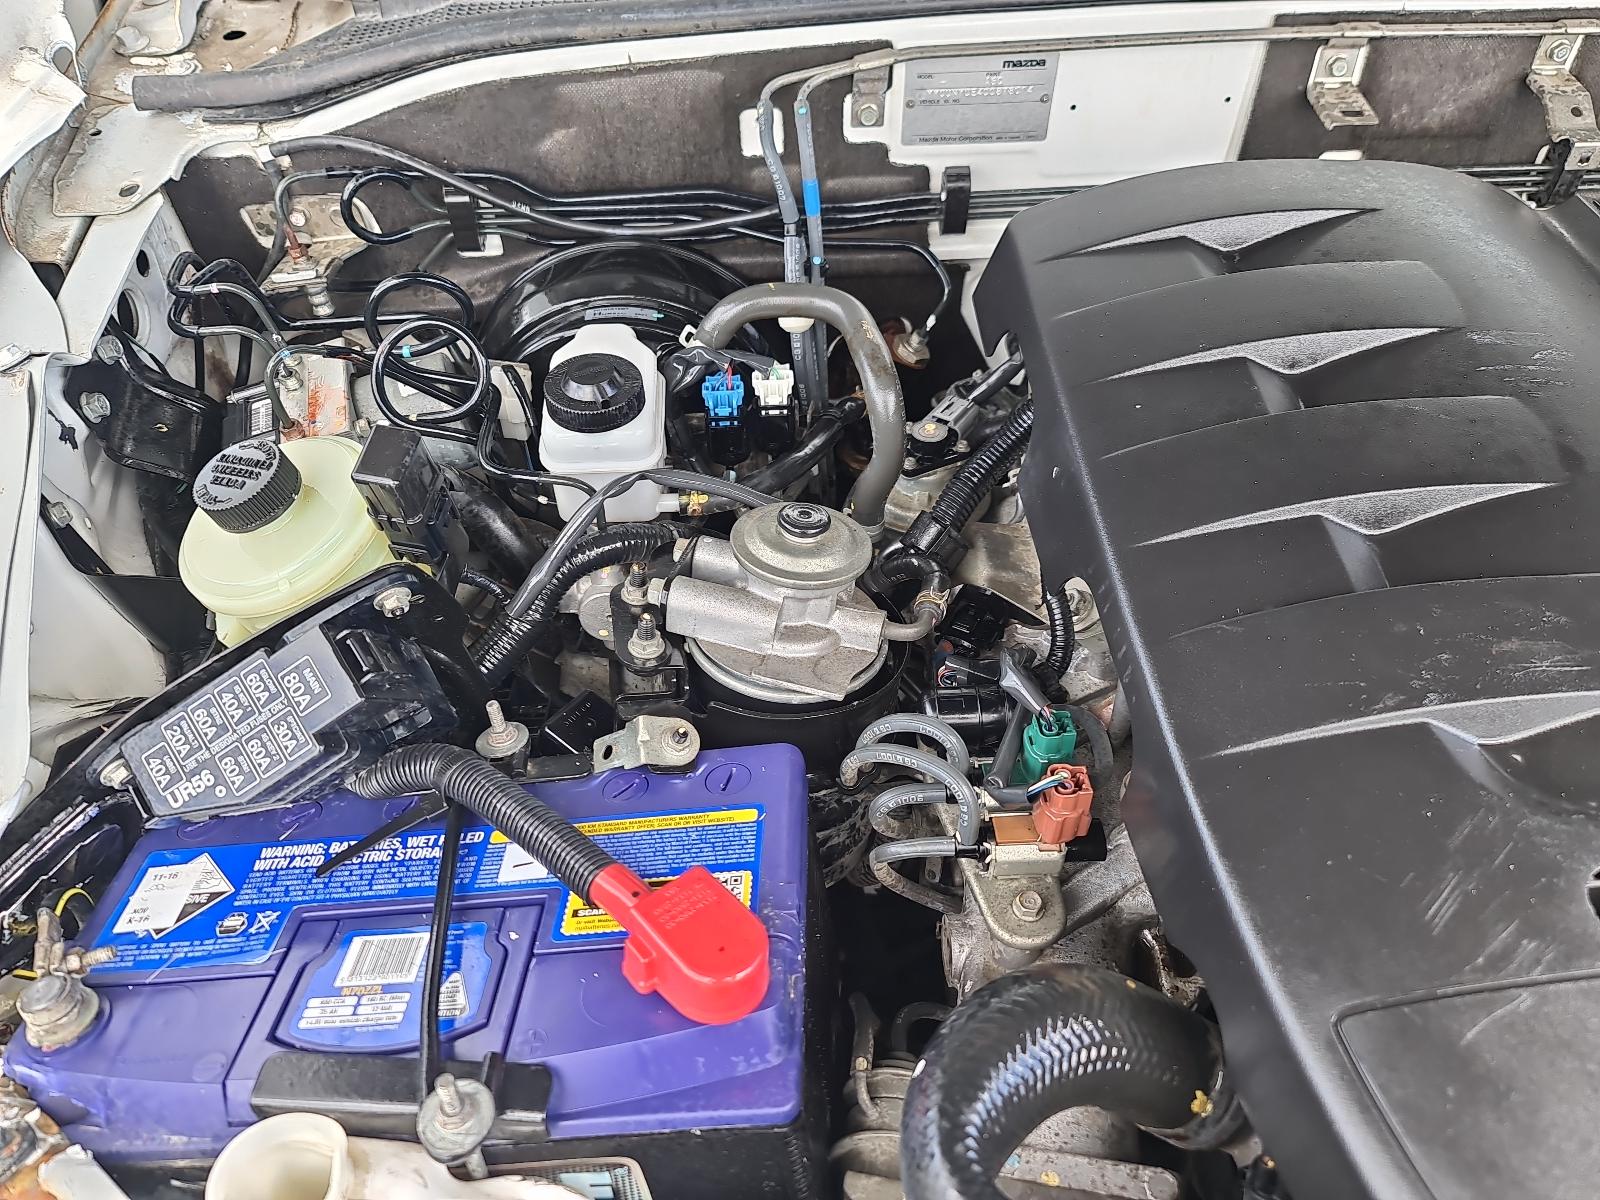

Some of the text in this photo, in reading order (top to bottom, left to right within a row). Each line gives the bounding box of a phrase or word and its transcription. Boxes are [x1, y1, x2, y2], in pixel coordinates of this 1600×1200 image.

[1002, 59, 1046, 68] mazda
[246, 672, 270, 705] 60A
[284, 672, 312, 711] 80A
[302, 668, 322, 694] MAIN
[194, 708, 218, 740] 60A
[221, 692, 244, 723] 40A
[166, 725, 191, 758] 20A
[182, 759, 198, 772] USE
[197, 750, 212, 763] THE
[270, 698, 289, 714] ONLY
[274, 720, 298, 754] 30A
[248, 738, 272, 772] 60A
[148, 758, 171, 789] 40A
[166, 769, 215, 808] UR56
[220, 756, 244, 790] 60A
[253, 858, 290, 872] WITH
[394, 846, 443, 860] STORA
[260, 832, 484, 858] WARNING: BAIES, WET FLED
